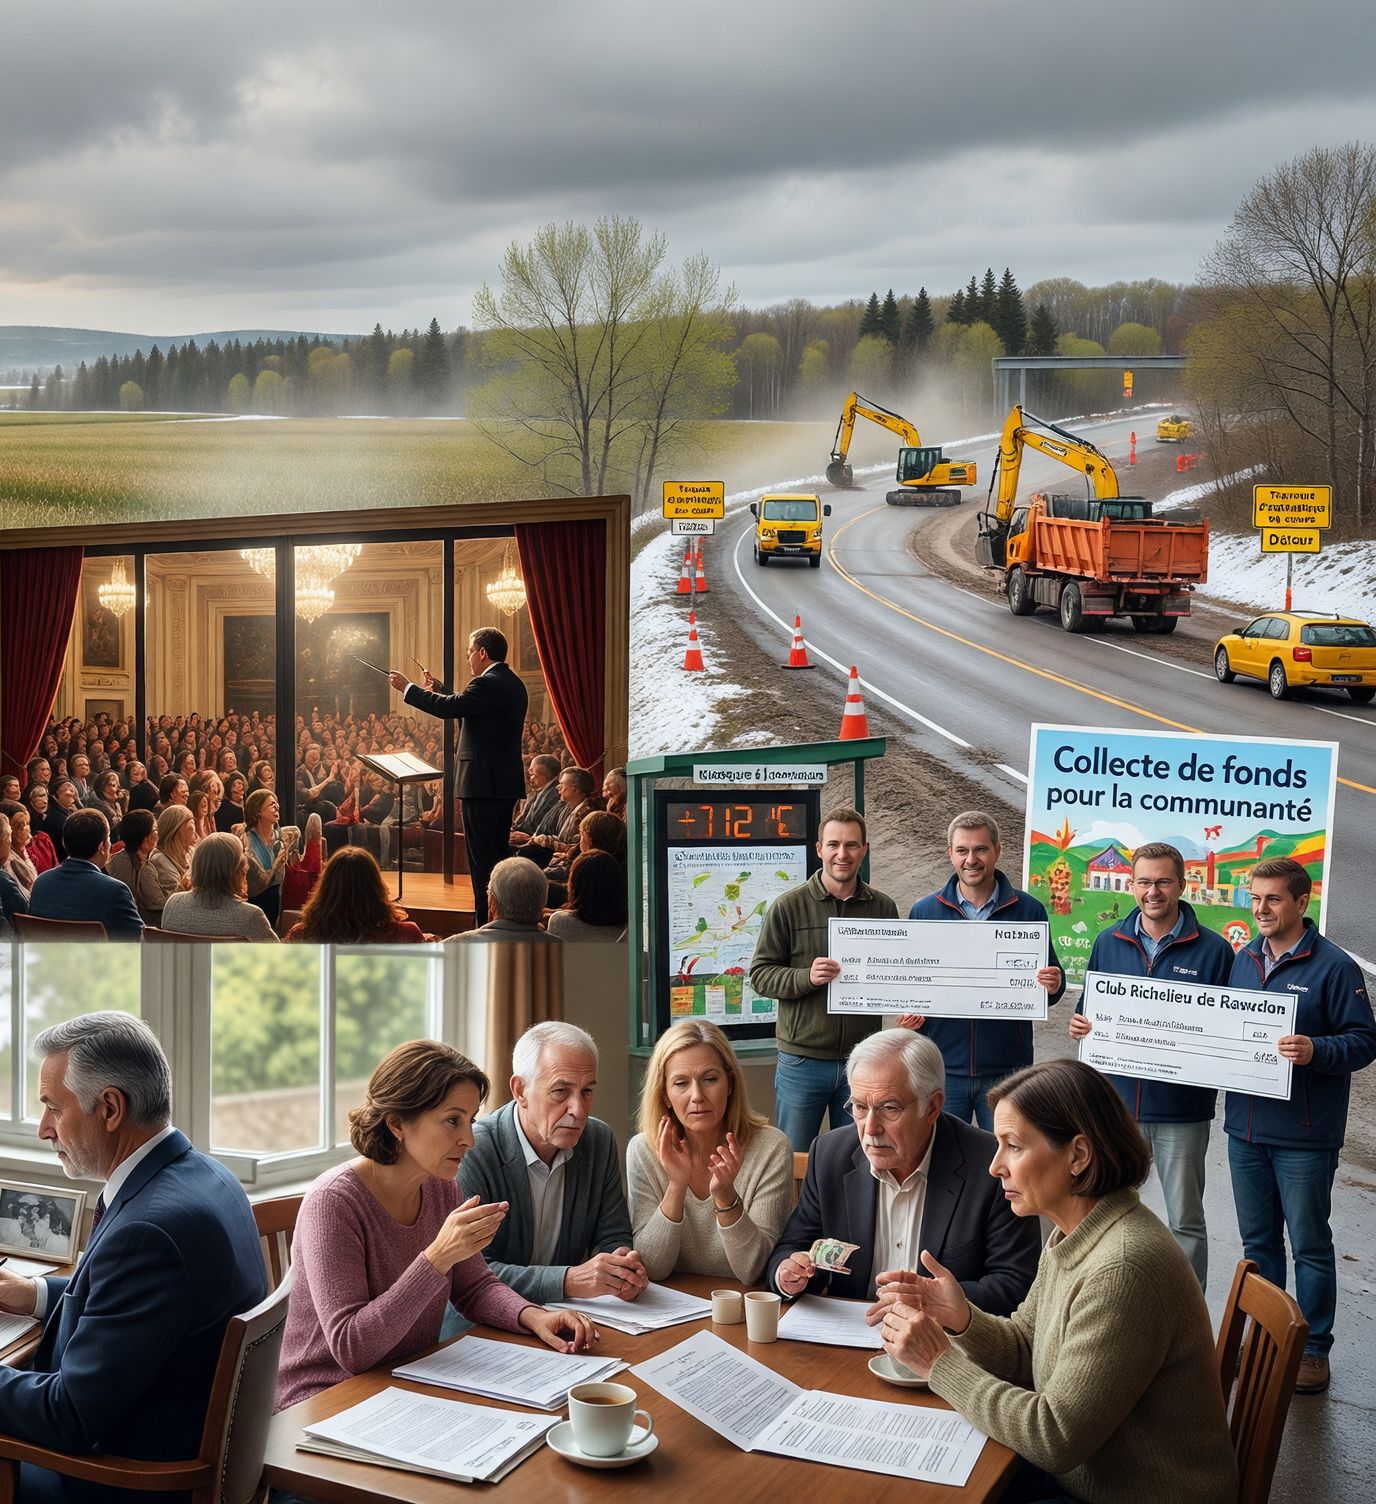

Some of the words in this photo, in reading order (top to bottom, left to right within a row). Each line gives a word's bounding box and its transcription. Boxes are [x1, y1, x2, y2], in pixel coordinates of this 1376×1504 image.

[1053, 745, 1171, 779] Collecte
[1177, 752, 1215, 783] de
[1222, 754, 1308, 789] fonds
[1046, 786, 1106, 811] pour
[1112, 783, 1133, 809] la
[1140, 793, 1313, 822] communanté
[1095, 979, 1126, 996] Club
[1130, 983, 1193, 1005] Richelieu
[1197, 992, 1215, 1007] de
